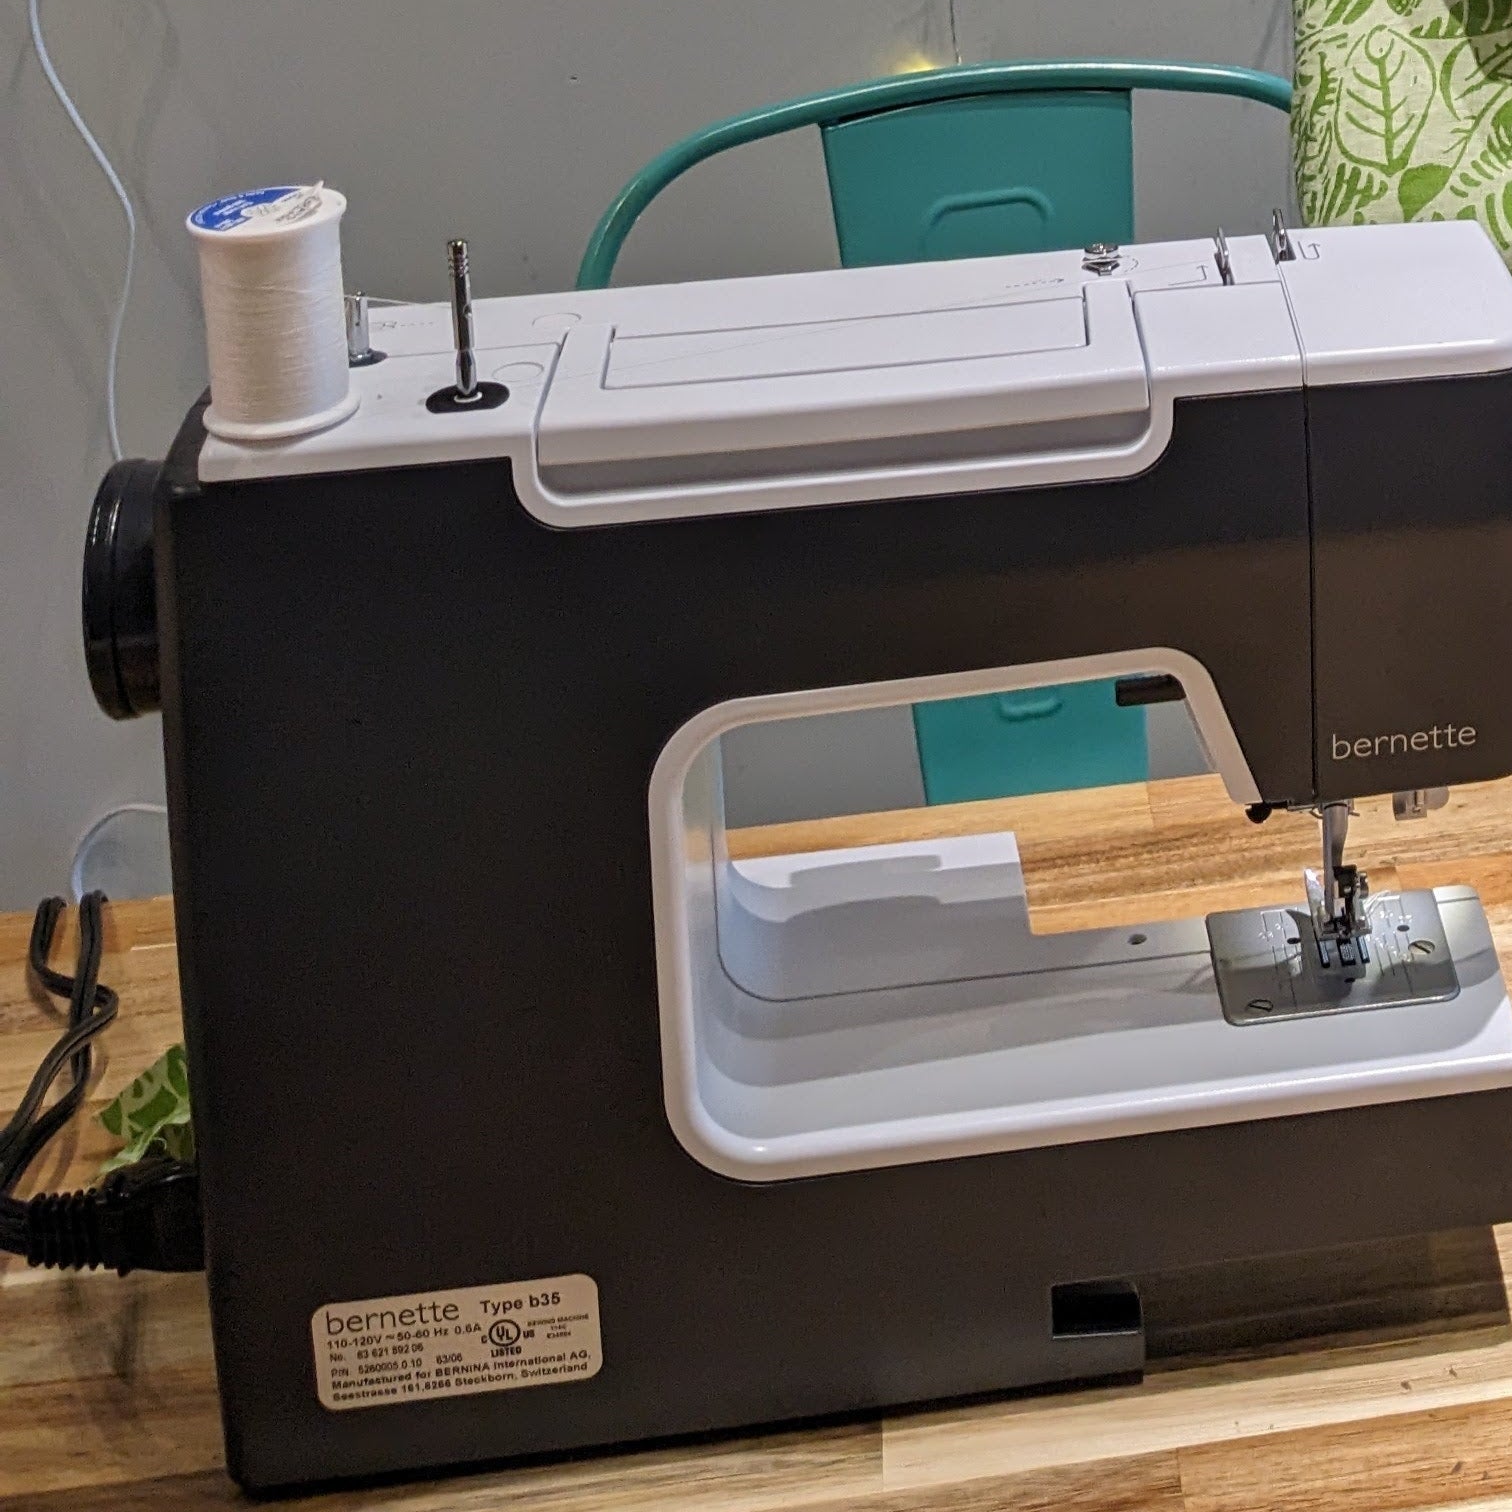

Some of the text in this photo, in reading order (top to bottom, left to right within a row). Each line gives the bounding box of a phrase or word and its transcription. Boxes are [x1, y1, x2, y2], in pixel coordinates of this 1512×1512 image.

[1332, 724, 1476, 760] bernette
[480, 1291, 562, 1317] Type b35
[326, 1301, 460, 1336] bernette
[328, 1335, 382, 1349] 110-120V
[434, 1327, 448, 1337] Hz
[490, 1346, 522, 1358] LISTED
[332, 1372, 412, 1390] Manufactured
[416, 1370, 431, 1380] for
[435, 1362, 490, 1377] BERNINA
[494, 1352, 566, 1370] International
[521, 1362, 588, 1379] Switzerland
